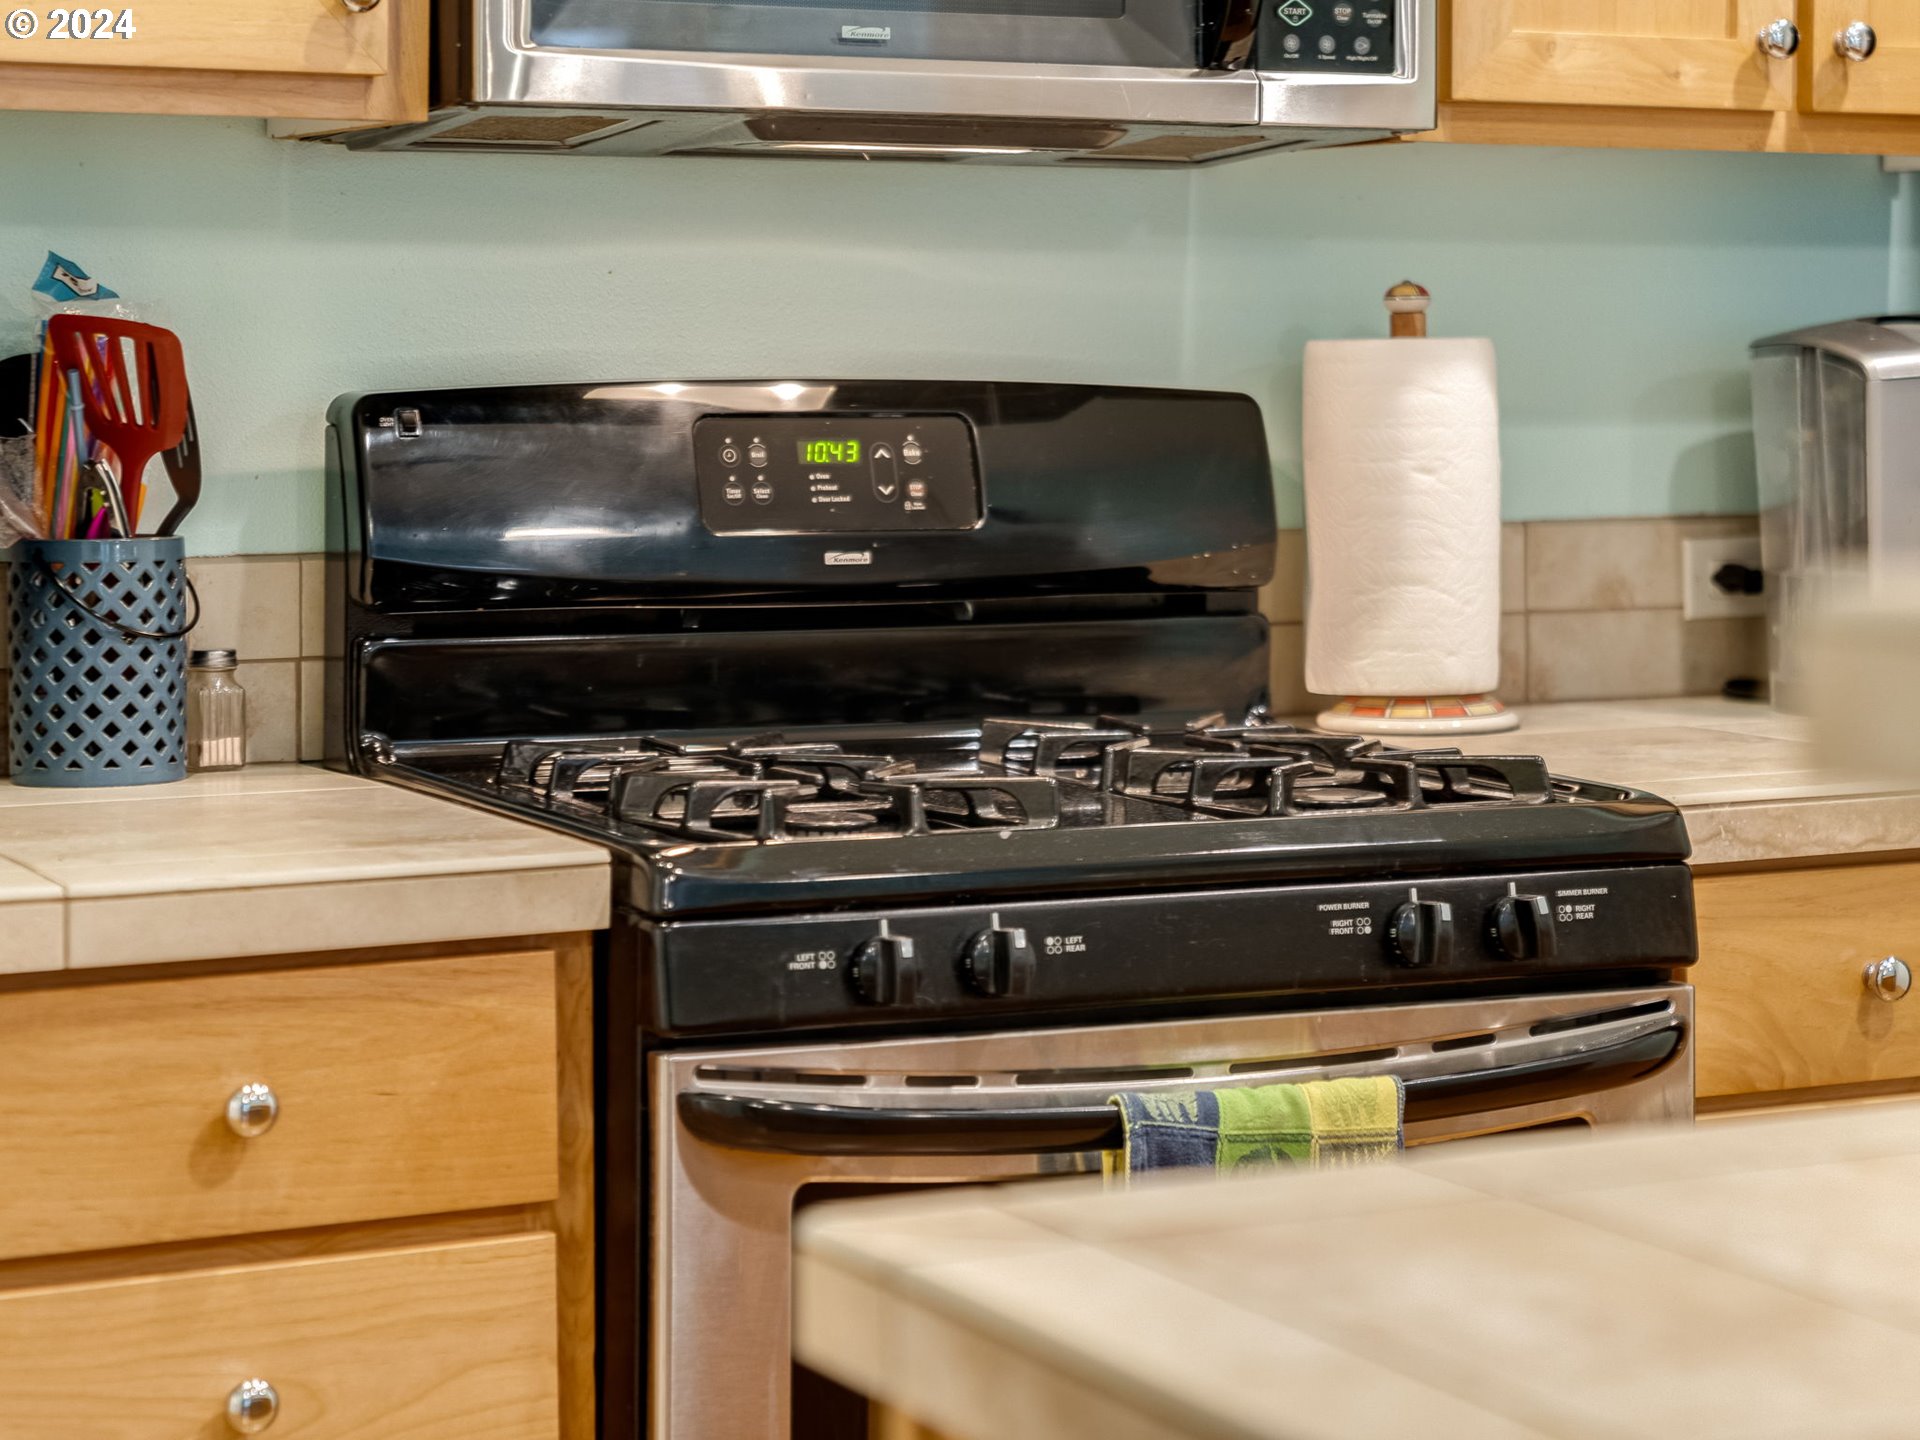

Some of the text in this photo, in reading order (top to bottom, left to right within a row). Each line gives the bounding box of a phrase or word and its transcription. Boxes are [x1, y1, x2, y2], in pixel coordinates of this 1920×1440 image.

[1283, 7, 1306, 15] START
[1334, 7, 1352, 15] STOP
[849, 30, 890, 39] Kenmore
[831, 555, 869, 564] Kenmore
[1557, 887, 1608, 897] SIMMER BURNER
[1317, 901, 1370, 911] POWER BURNER
[1574, 903, 1595, 912] RIGHT
[1575, 911, 1594, 920] REAR
[1331, 919, 1354, 927] RIGHT
[1329, 927, 1354, 935] FRONT
[1065, 936, 1083, 944] LEFT
[1065, 944, 1086, 952] REAR
[796, 953, 815, 961] LEFT
[788, 961, 816, 970] FRONT
